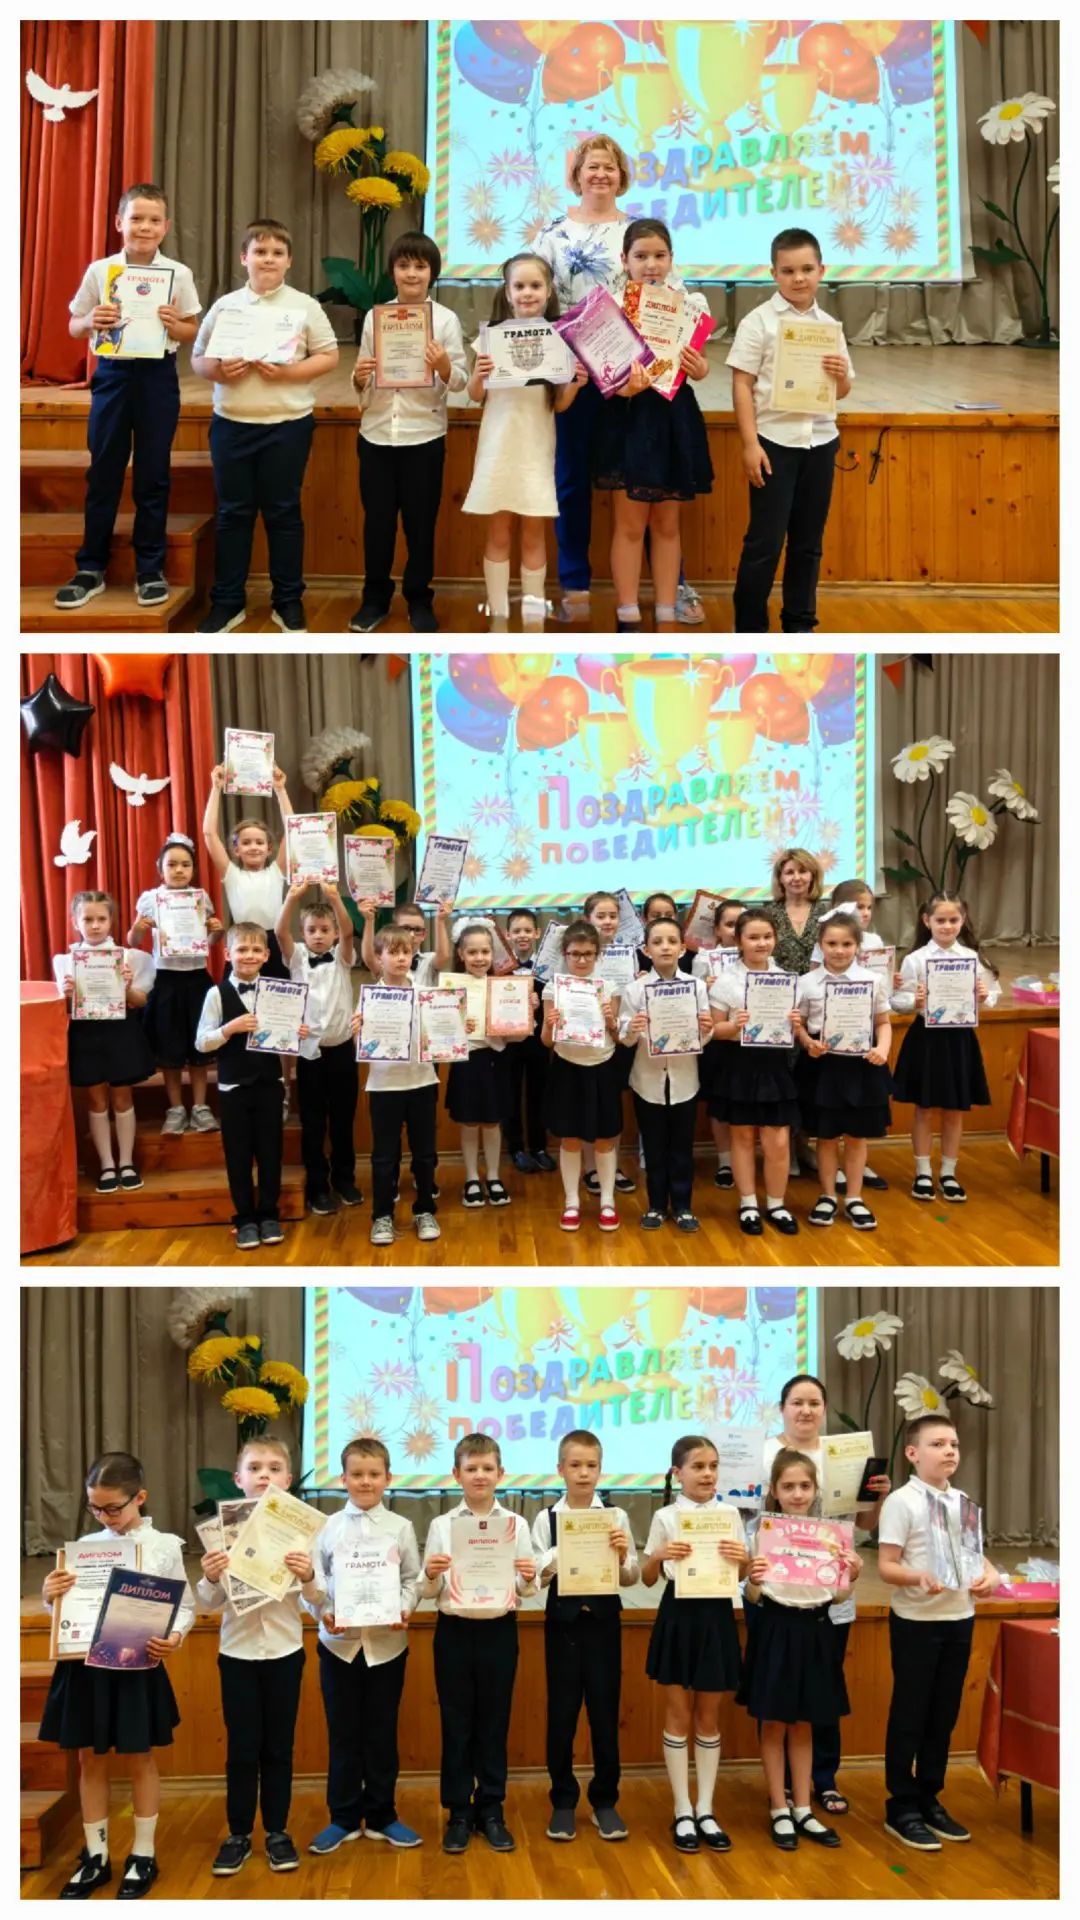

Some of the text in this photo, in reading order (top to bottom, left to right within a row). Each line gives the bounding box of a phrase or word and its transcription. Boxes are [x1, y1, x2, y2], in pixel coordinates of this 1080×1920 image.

[565, 131, 869, 192] ЗДРАВЛЯЕМ
[503, 328, 552, 338] ГРАМОТА
[538, 769, 800, 831] ПОЗДРАВЛЯЕМ
[755, 978, 791, 986] ГРАМОТА
[834, 986, 868, 996] ГРАМОТА
[371, 992, 408, 1001] ГРАМОТА
[446, 1342, 737, 1403] ПОЗДРАВЛЯЕМ
[78, 1551, 123, 1560] ДИПЛОМ
[345, 1561, 388, 1569] ГРАМОТА
[118, 1583, 172, 1601] ДИПЛОМ
